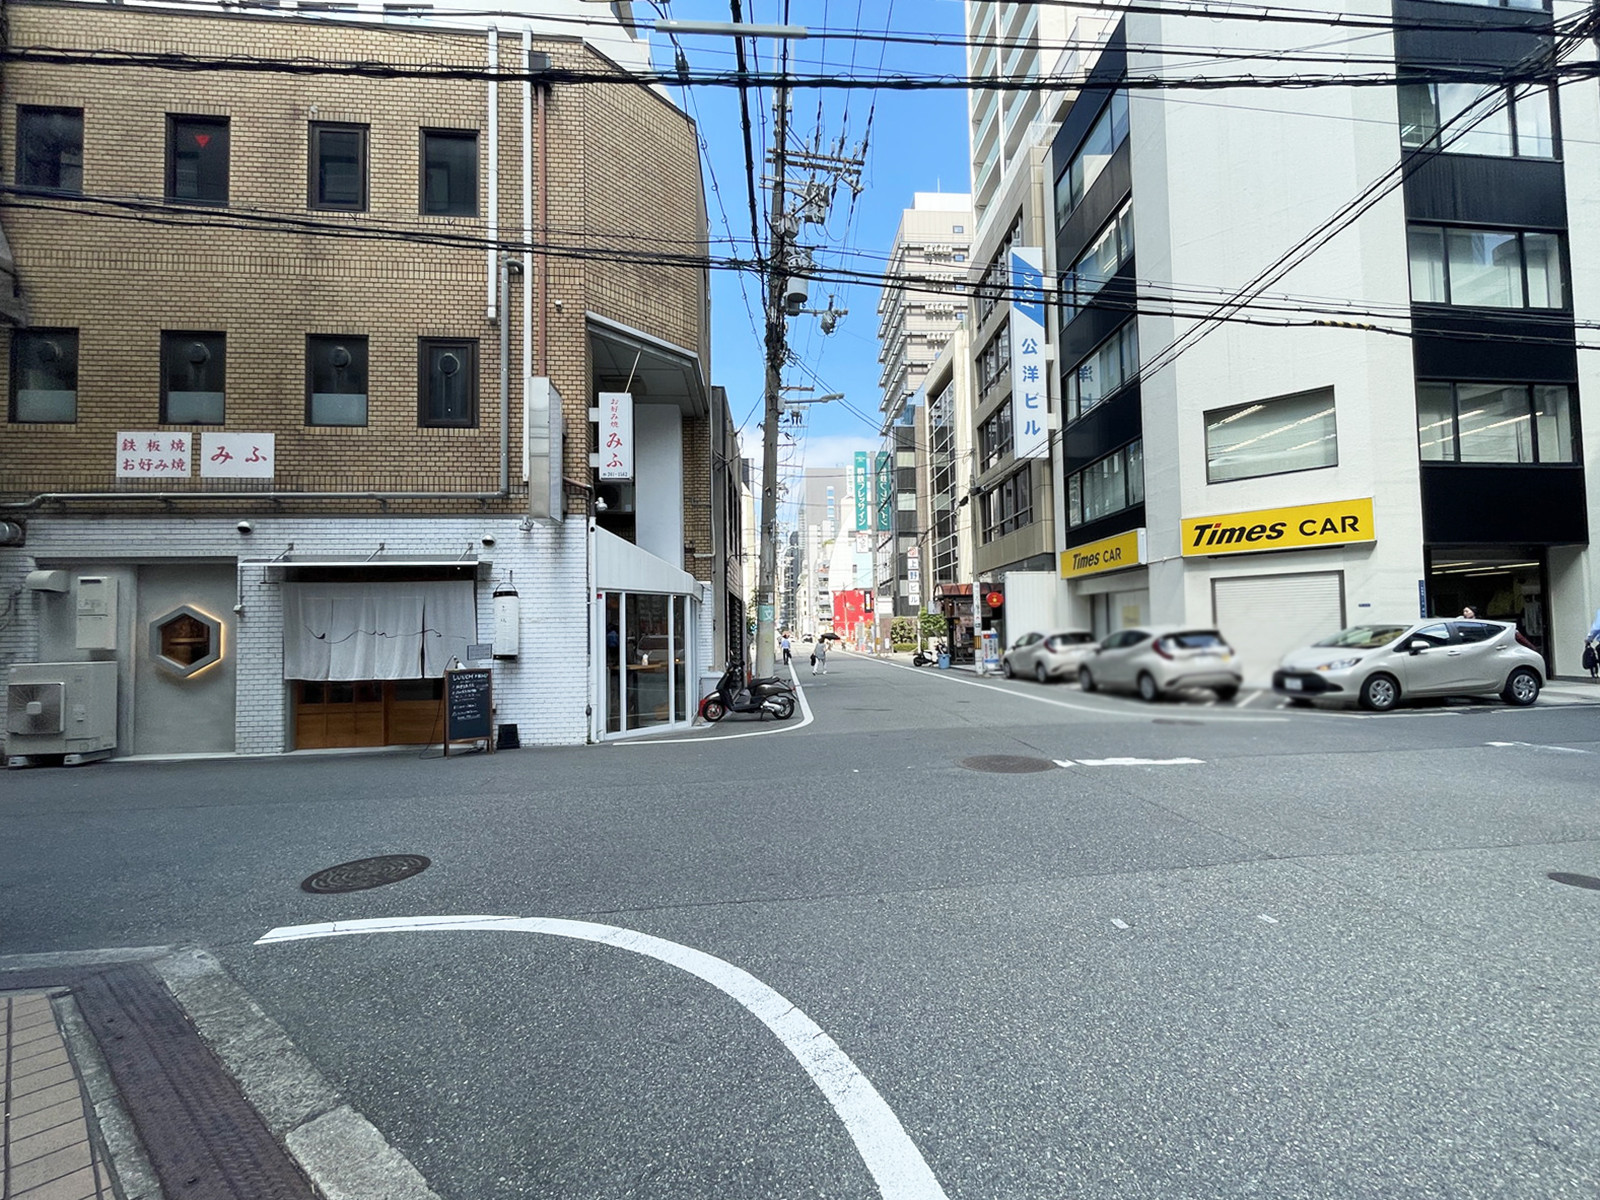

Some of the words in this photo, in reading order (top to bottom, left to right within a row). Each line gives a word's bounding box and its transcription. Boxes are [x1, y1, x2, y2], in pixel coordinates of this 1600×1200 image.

[1021, 338, 1041, 436] 公洋ビル
[610, 398, 619, 428] お好み焼
[122, 438, 186, 452] 鉄板焼
[211, 446, 268, 465] みふ
[606, 432, 623, 468] みふ
[123, 458, 187, 472] お好み焼
[1193, 521, 1287, 547] Times
[1299, 515, 1359, 537] CAR
[1072, 551, 1099, 570] Times
[1103, 547, 1122, 563] CAR
[909, 560, 918, 603] 上野ビル
